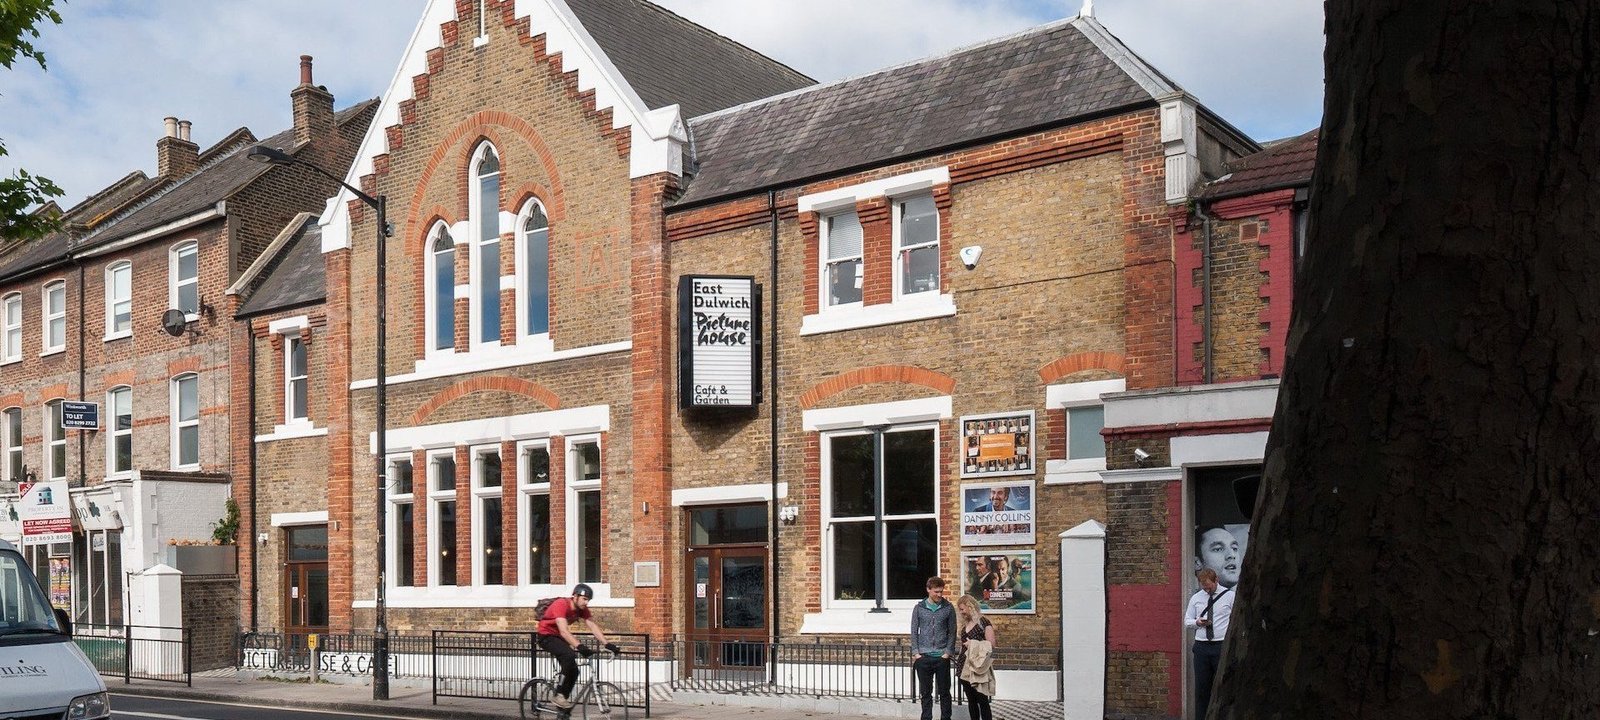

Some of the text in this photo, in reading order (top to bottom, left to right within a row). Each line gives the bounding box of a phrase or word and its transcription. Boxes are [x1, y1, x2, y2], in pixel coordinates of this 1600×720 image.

[694, 282, 722, 294] East
[694, 296, 750, 308] Dulwich
[694, 312, 750, 331] Picture
[698, 326, 746, 346] house
[695, 385, 728, 397] Café &
[695, 395, 730, 404] Garden
[965, 513, 1031, 523] DANNY COLLINS
[0, 665, 46, 674] ILING
[342, 655, 351, 672] &
